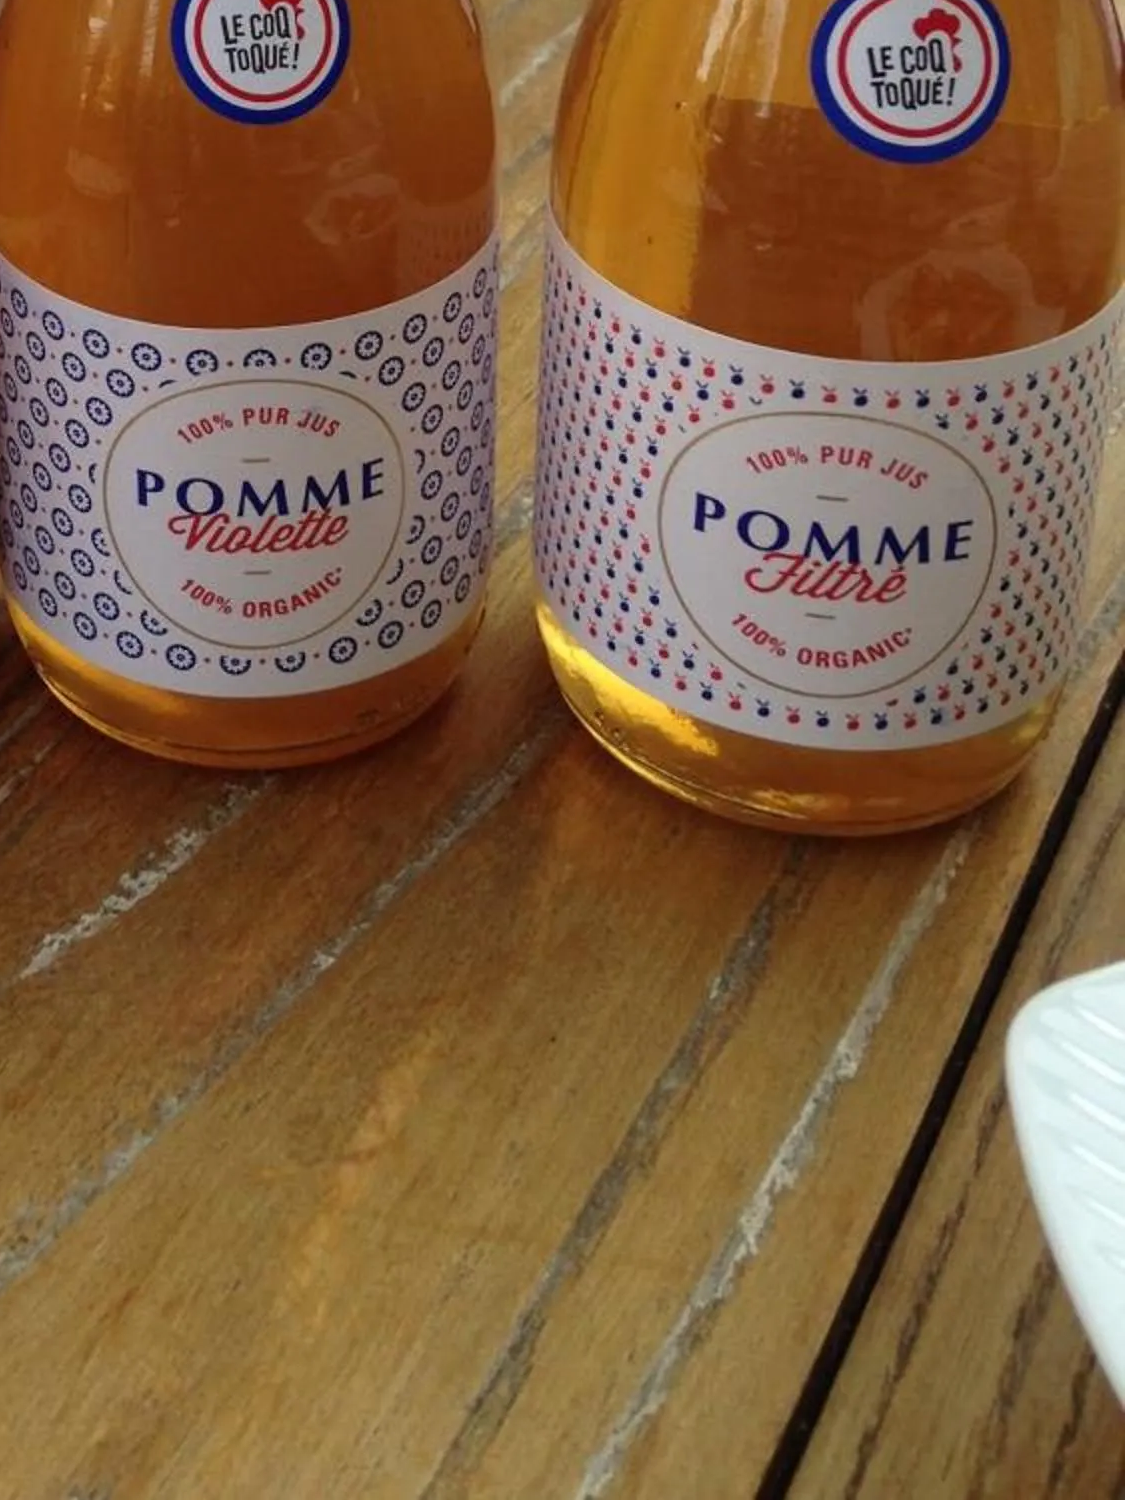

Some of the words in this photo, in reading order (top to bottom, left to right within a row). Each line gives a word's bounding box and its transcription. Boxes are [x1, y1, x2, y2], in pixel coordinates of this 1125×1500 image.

[221, 14, 244, 44] LE
[249, 6, 291, 40] COQ
[867, 47, 894, 79] LE
[900, 38, 946, 74] COQ
[177, 412, 234, 444] 100%
[242, 406, 290, 427] PUR
[296, 409, 340, 438] JUS
[135, 457, 384, 518] POMME
[745, 446, 809, 474] 100%
[820, 445, 873, 470] PUR
[880, 458, 929, 490] JUS
[168, 505, 350, 554] Violette
[692, 491, 974, 565] POMME
[180, 578, 233, 616] 100%
[744, 551, 907, 603] Filtré
[731, 612, 787, 658] 100%
